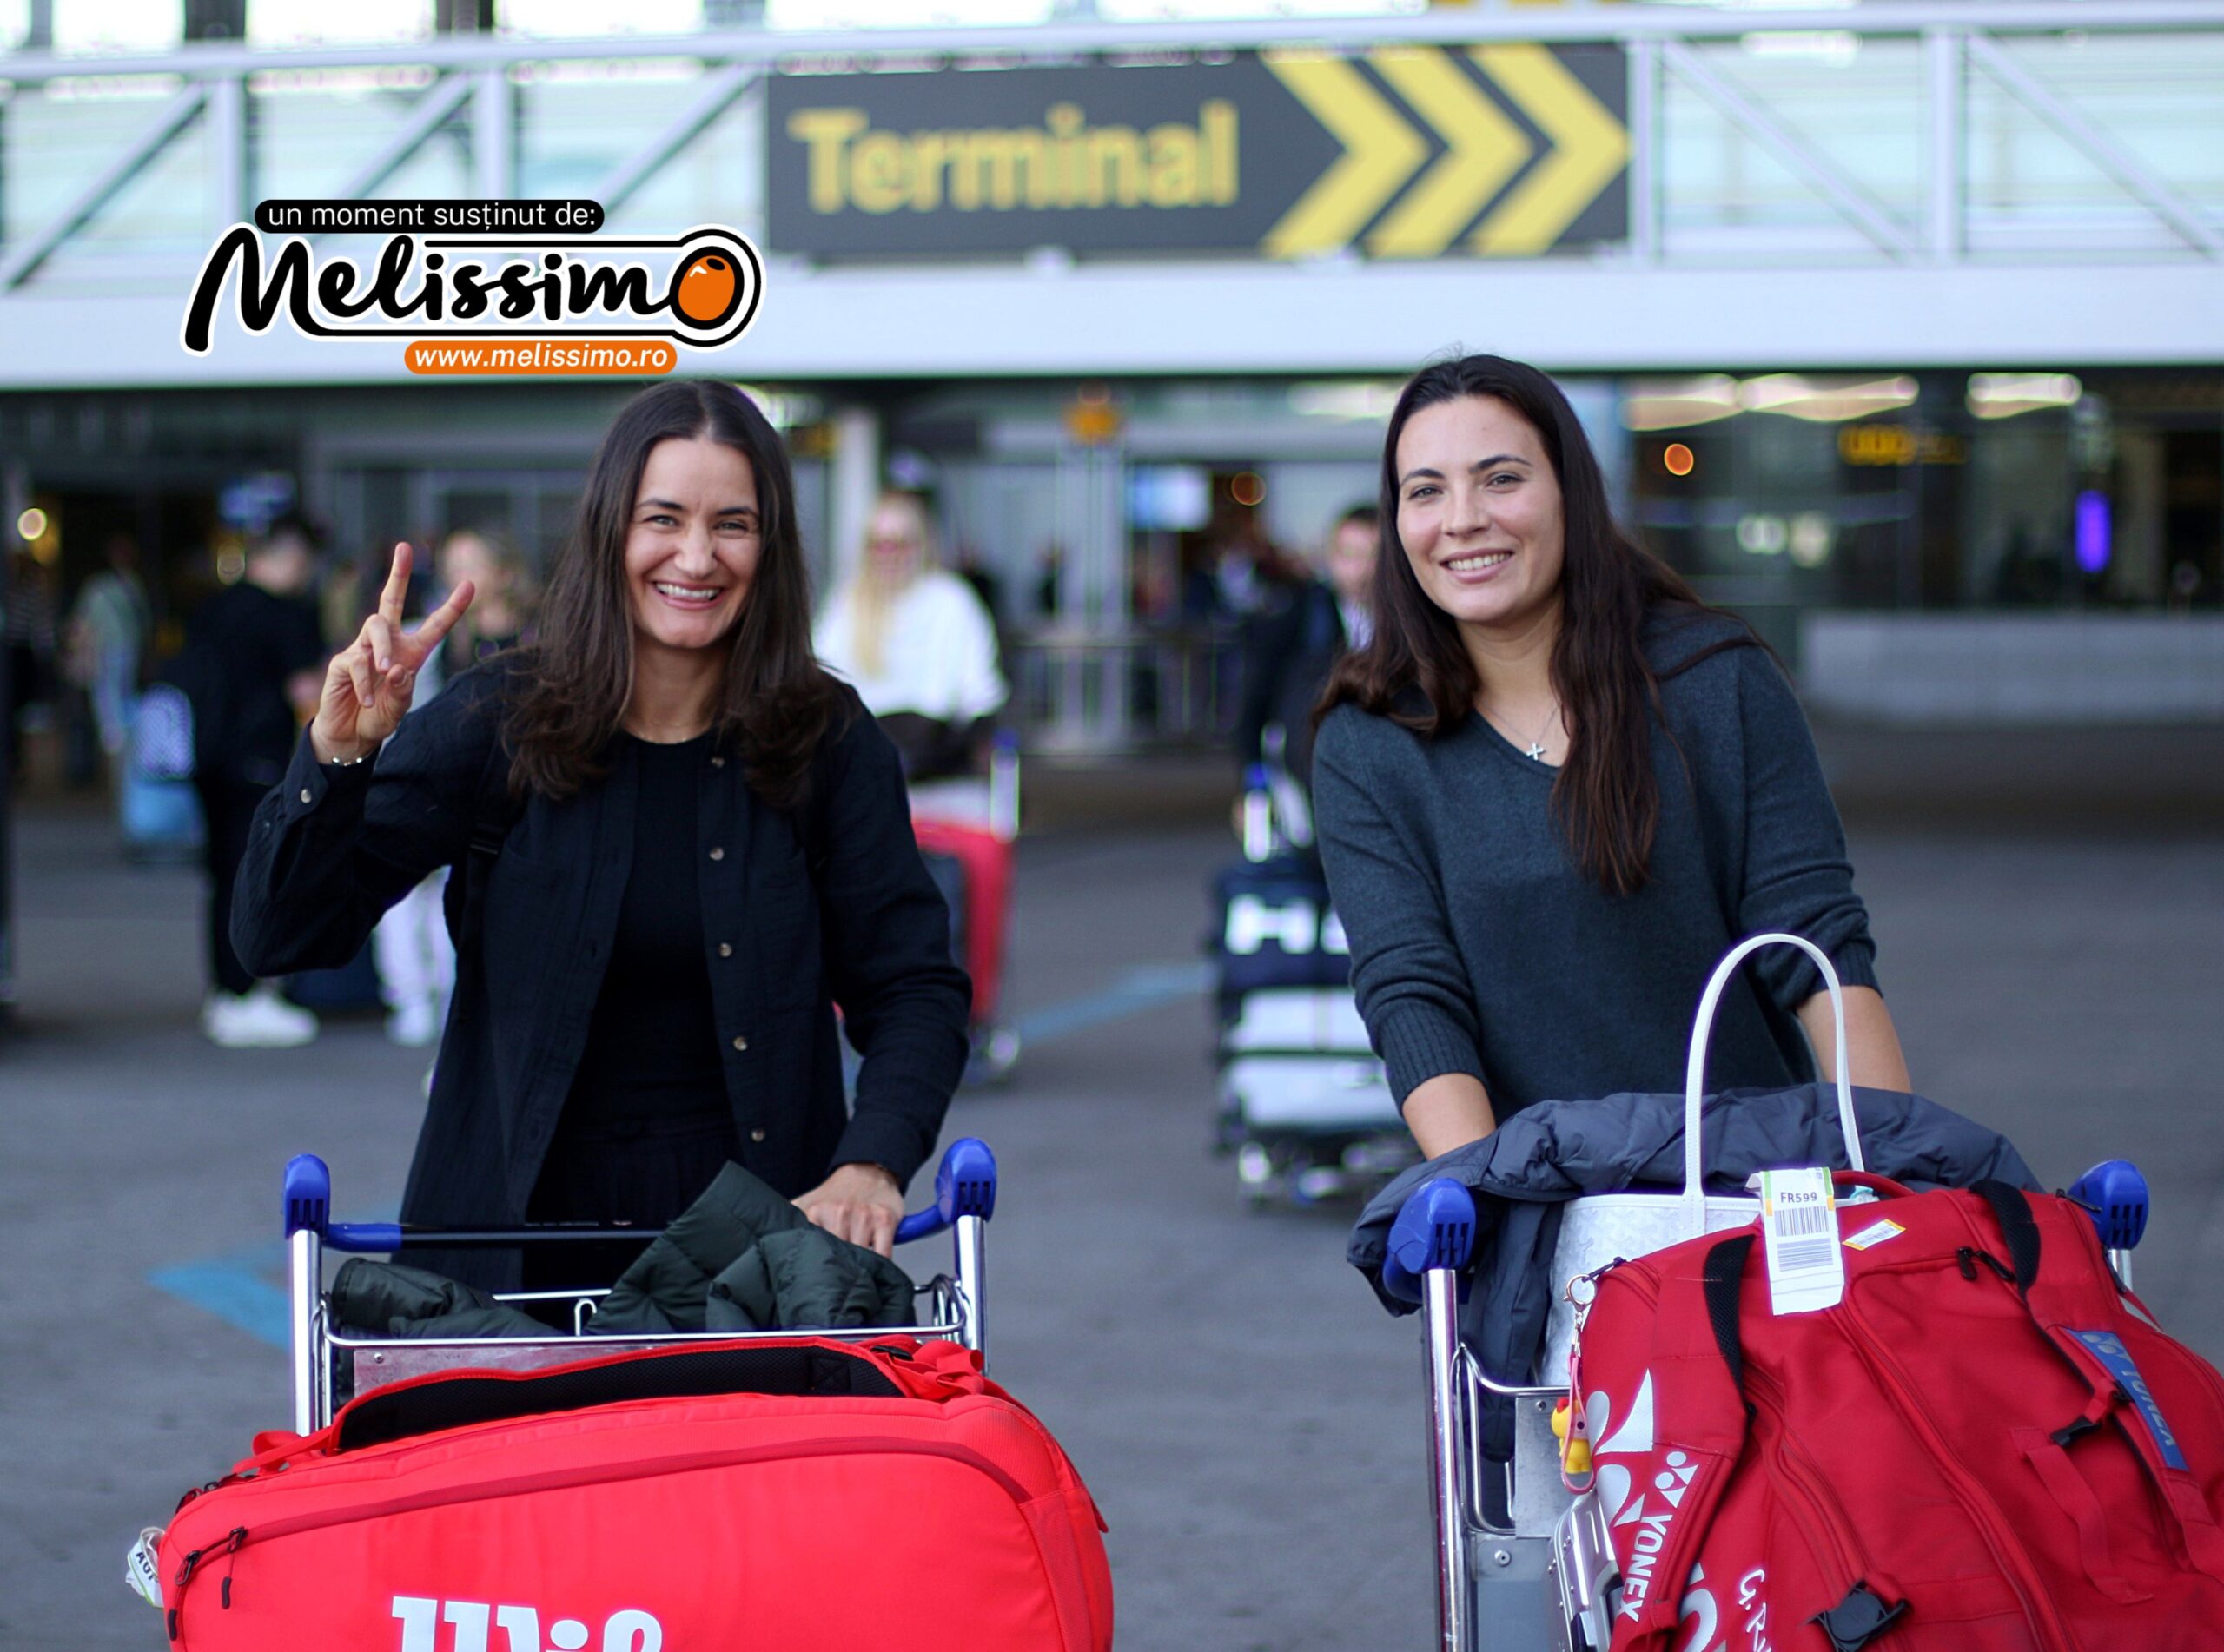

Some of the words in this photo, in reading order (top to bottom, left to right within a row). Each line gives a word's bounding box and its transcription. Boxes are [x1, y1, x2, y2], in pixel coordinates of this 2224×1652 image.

[787, 99, 1239, 214] Terminal
[1780, 1191, 1817, 1203] FR599
[1620, 1514, 1673, 1622] YONEX
